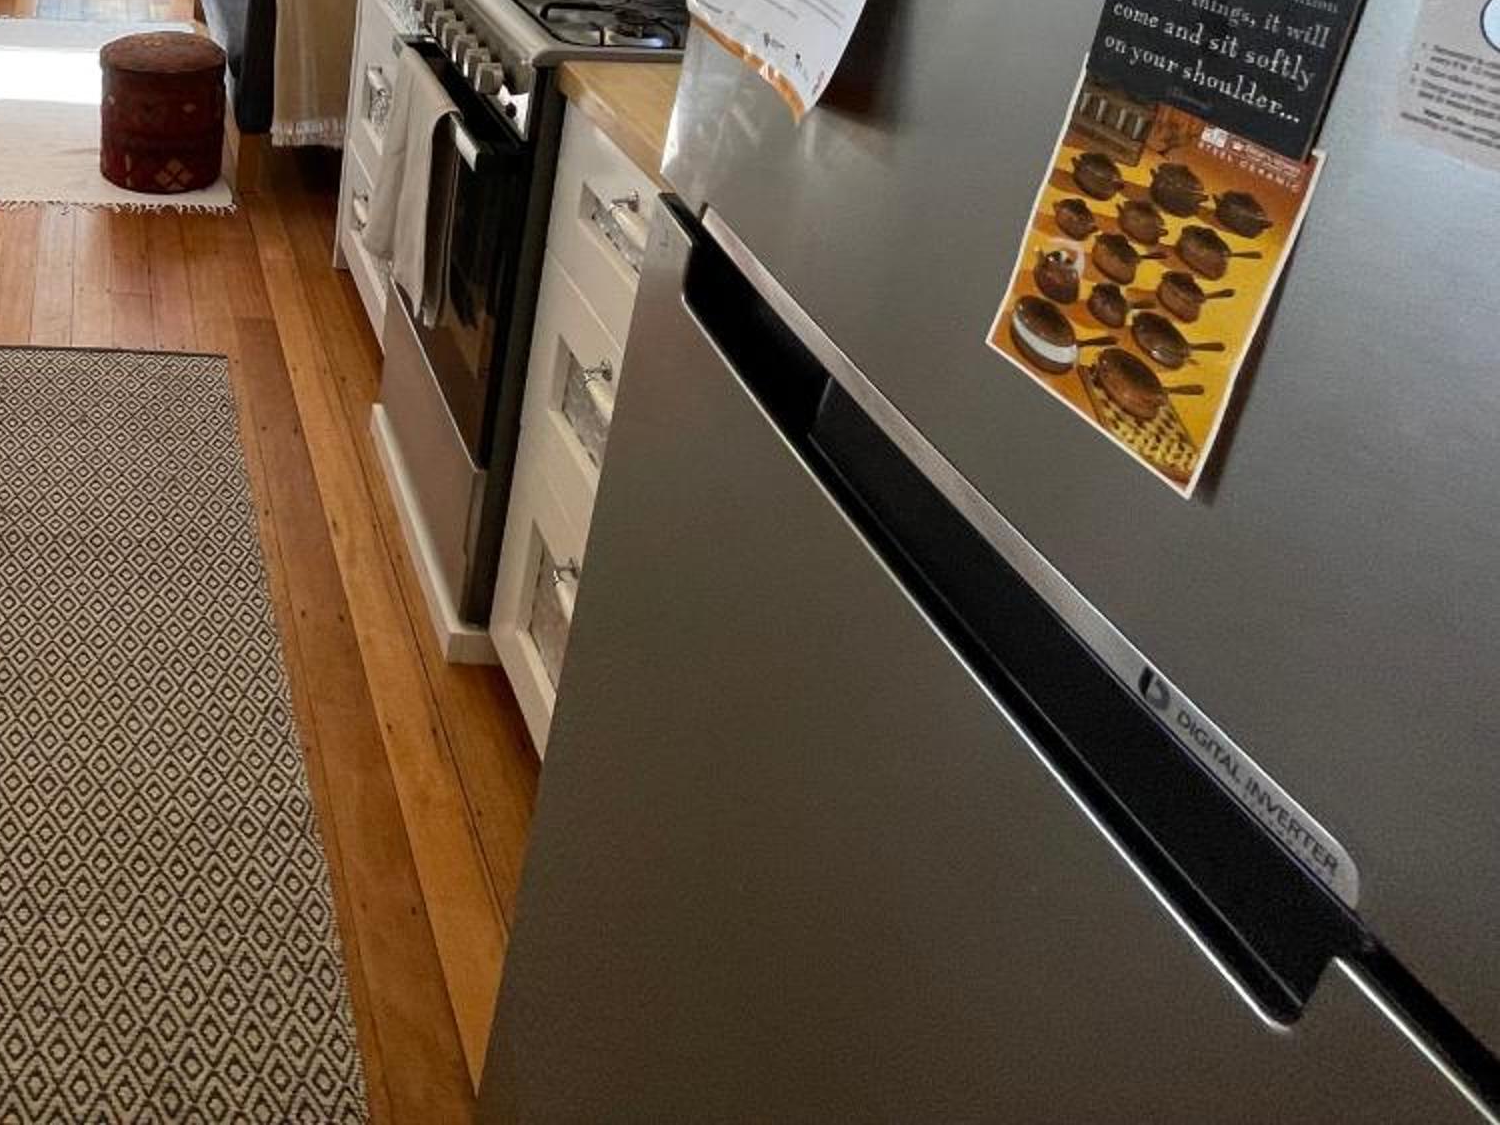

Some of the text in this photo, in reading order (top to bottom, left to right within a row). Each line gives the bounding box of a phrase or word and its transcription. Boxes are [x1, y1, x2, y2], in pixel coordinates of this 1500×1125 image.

[1104, 35, 1126, 54] on
[1129, 45, 1179, 74] your
[1113, 2, 1317, 92] come and sit softly
[1264, 12, 1280, 34] it
[1287, 24, 1331, 49] will
[1177, 710, 1340, 873] DIGITAL INVERTER
